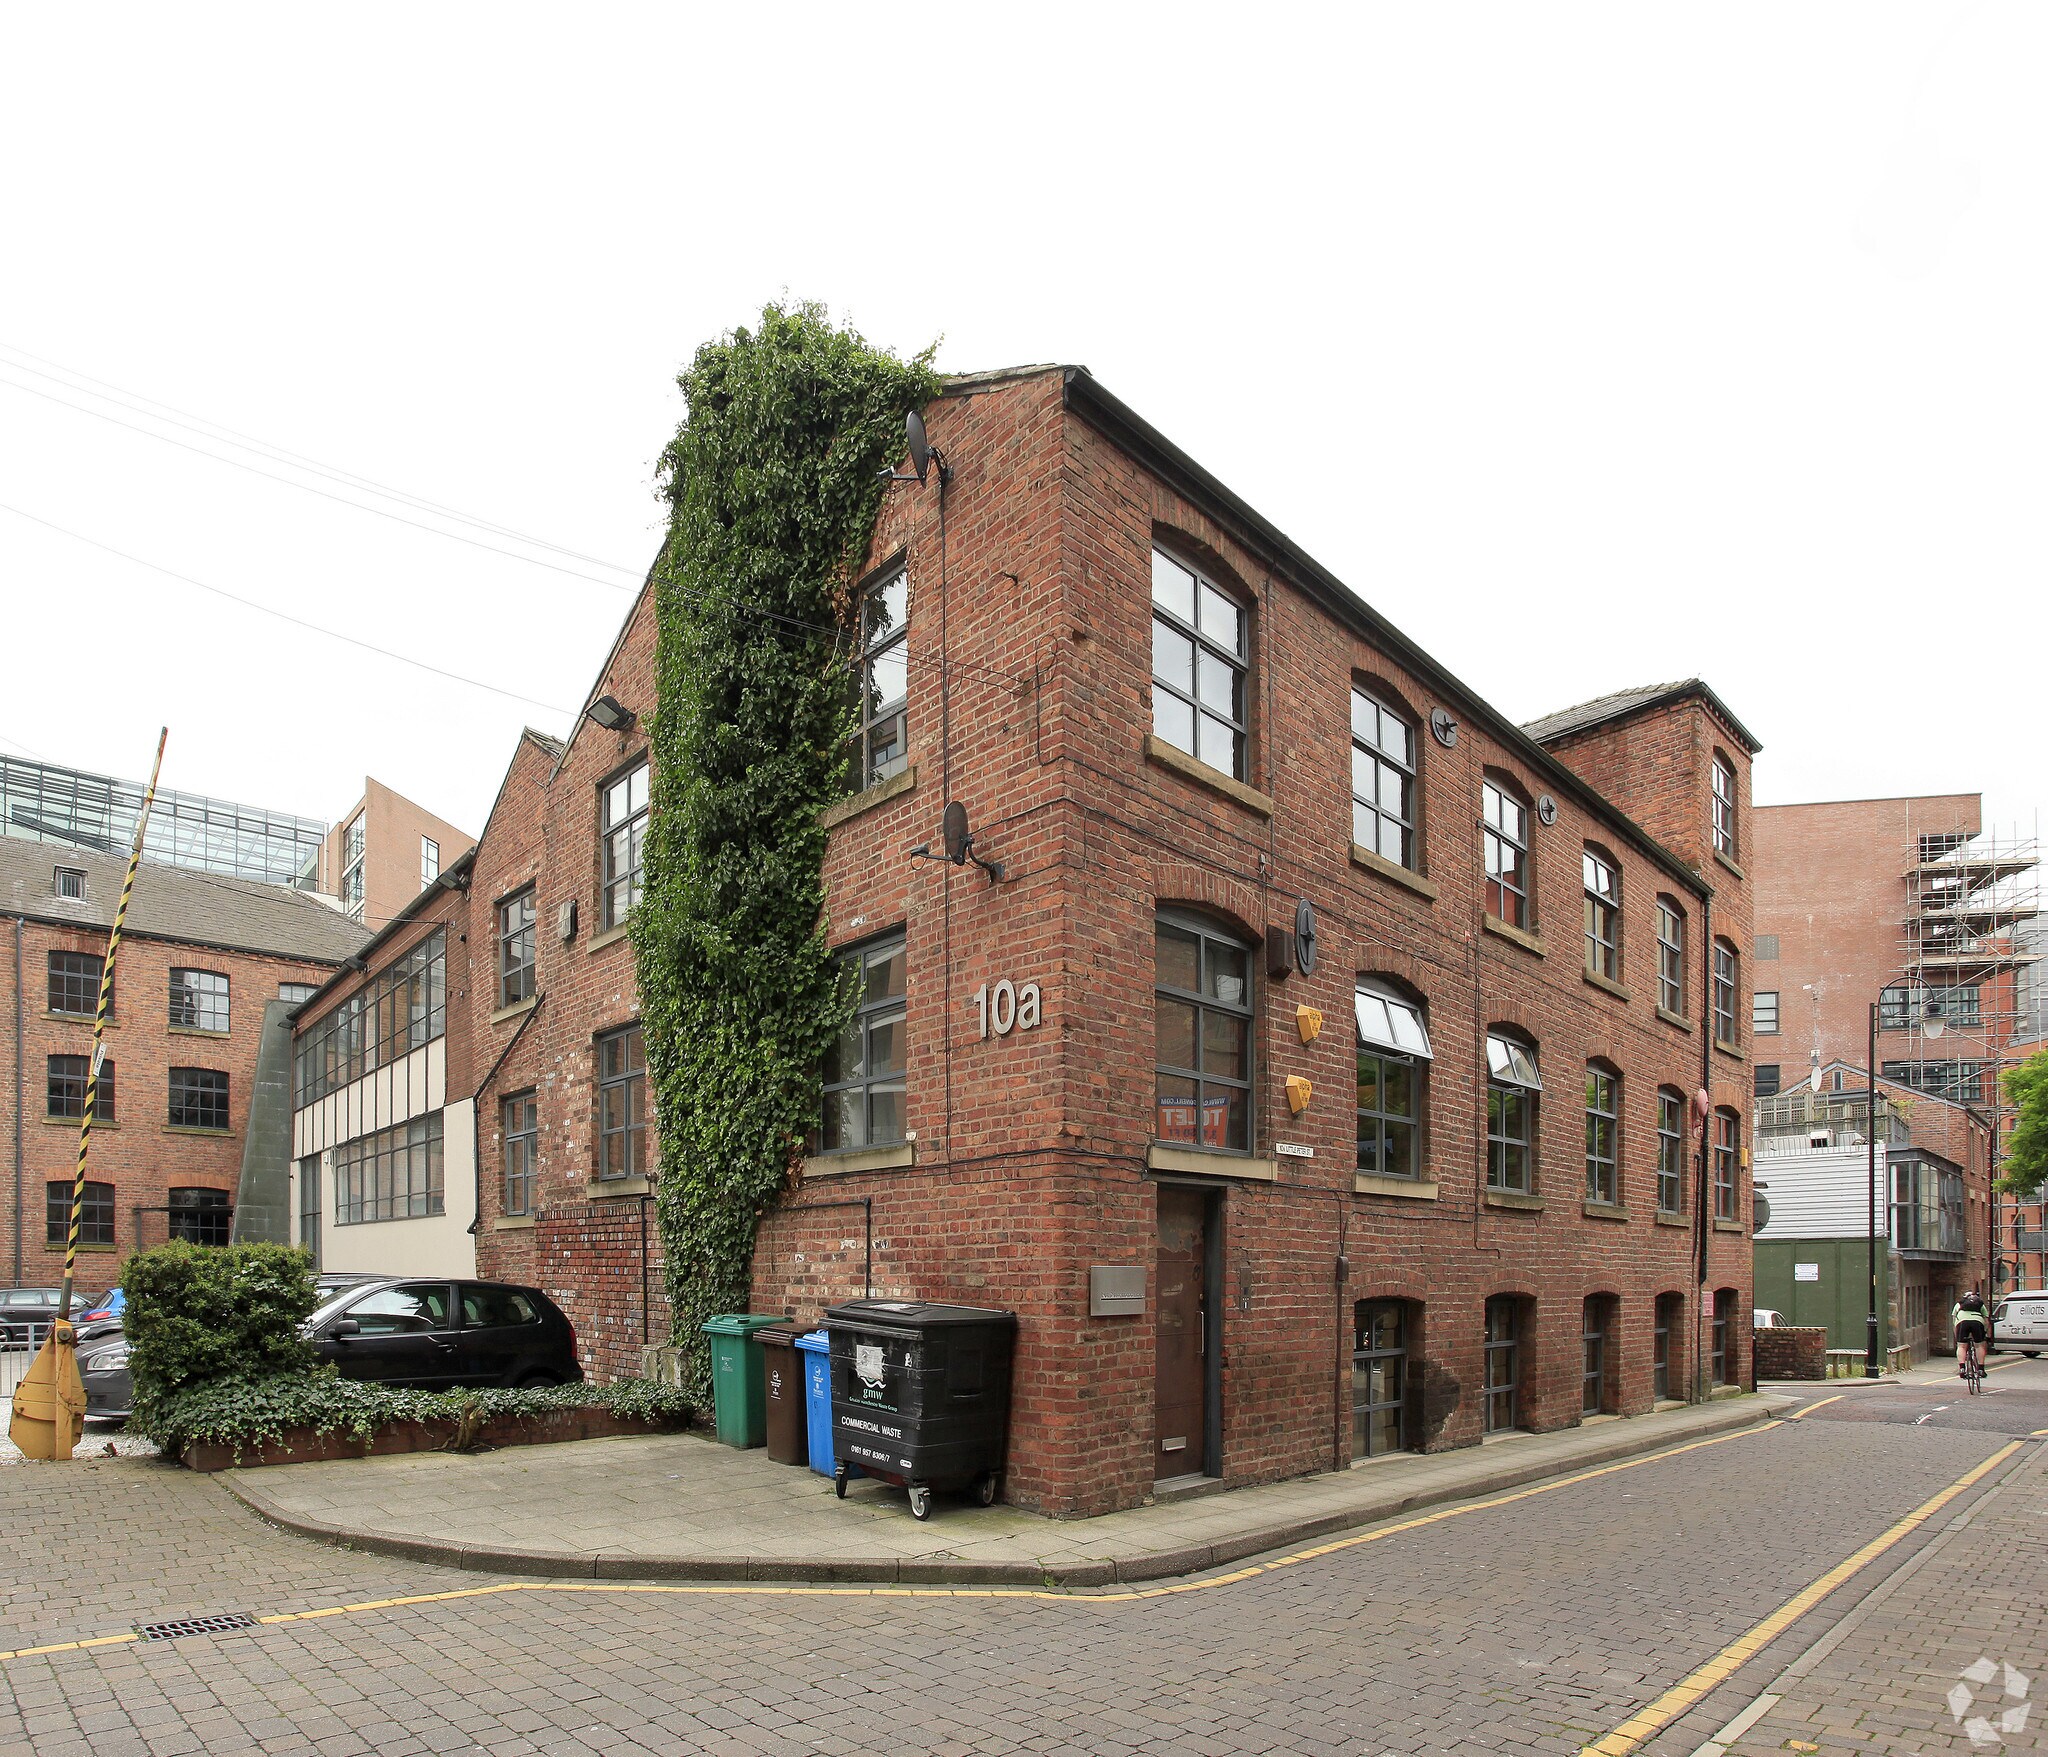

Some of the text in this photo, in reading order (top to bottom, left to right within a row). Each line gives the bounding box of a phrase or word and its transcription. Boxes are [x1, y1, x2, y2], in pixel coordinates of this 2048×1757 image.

[974, 979, 1040, 1037] 10a
[2020, 1305, 2045, 1316] elliotts
[863, 1388, 883, 1400] gmw
[841, 1416, 901, 1438] COMMERCIAL WASTE
[851, 1444, 862, 1455] 0161
